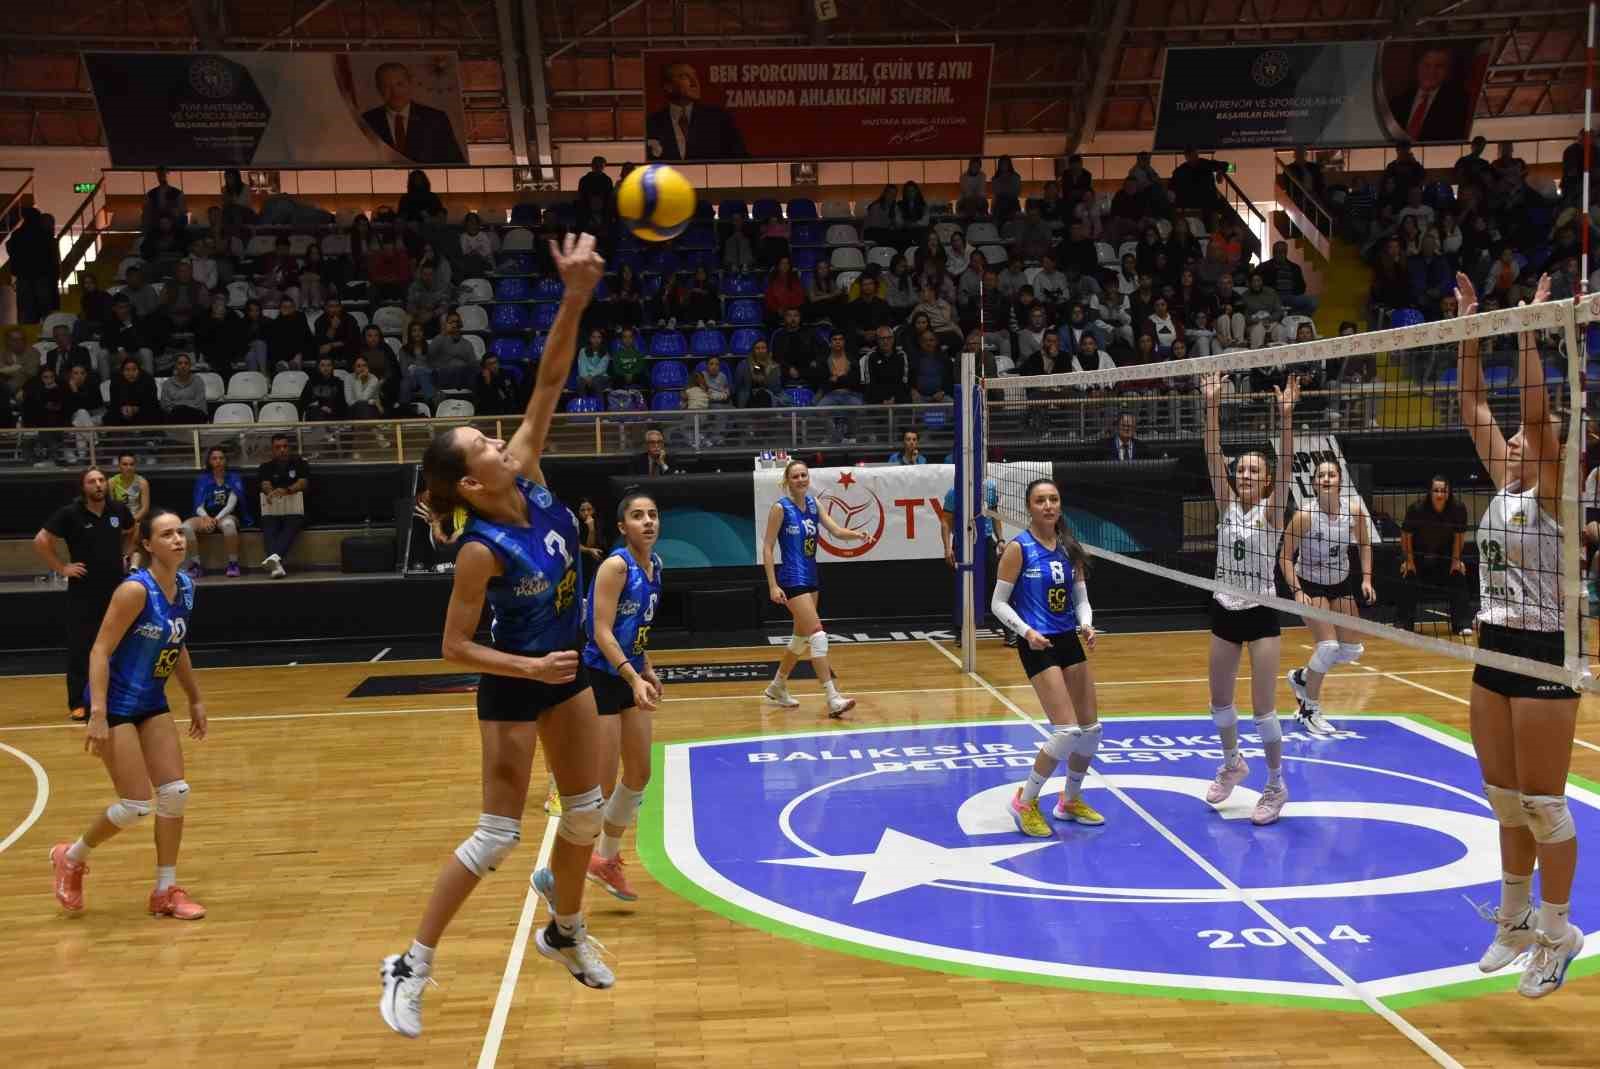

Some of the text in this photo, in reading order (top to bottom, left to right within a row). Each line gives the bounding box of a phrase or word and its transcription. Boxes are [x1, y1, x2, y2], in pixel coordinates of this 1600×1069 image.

[709, 57, 973, 86] BEN SPORCUNUN ZEKİ, ÇEVİK VE AYNI
[725, 88, 796, 107] ZAMANDA
[888, 82, 955, 105] SEVERİM.
[1234, 539, 1245, 561] 6
[747, 741, 1017, 763] BALIKESİR
[873, 748, 1267, 773] BELEDESPOR
[1197, 924, 1371, 948] 2014
